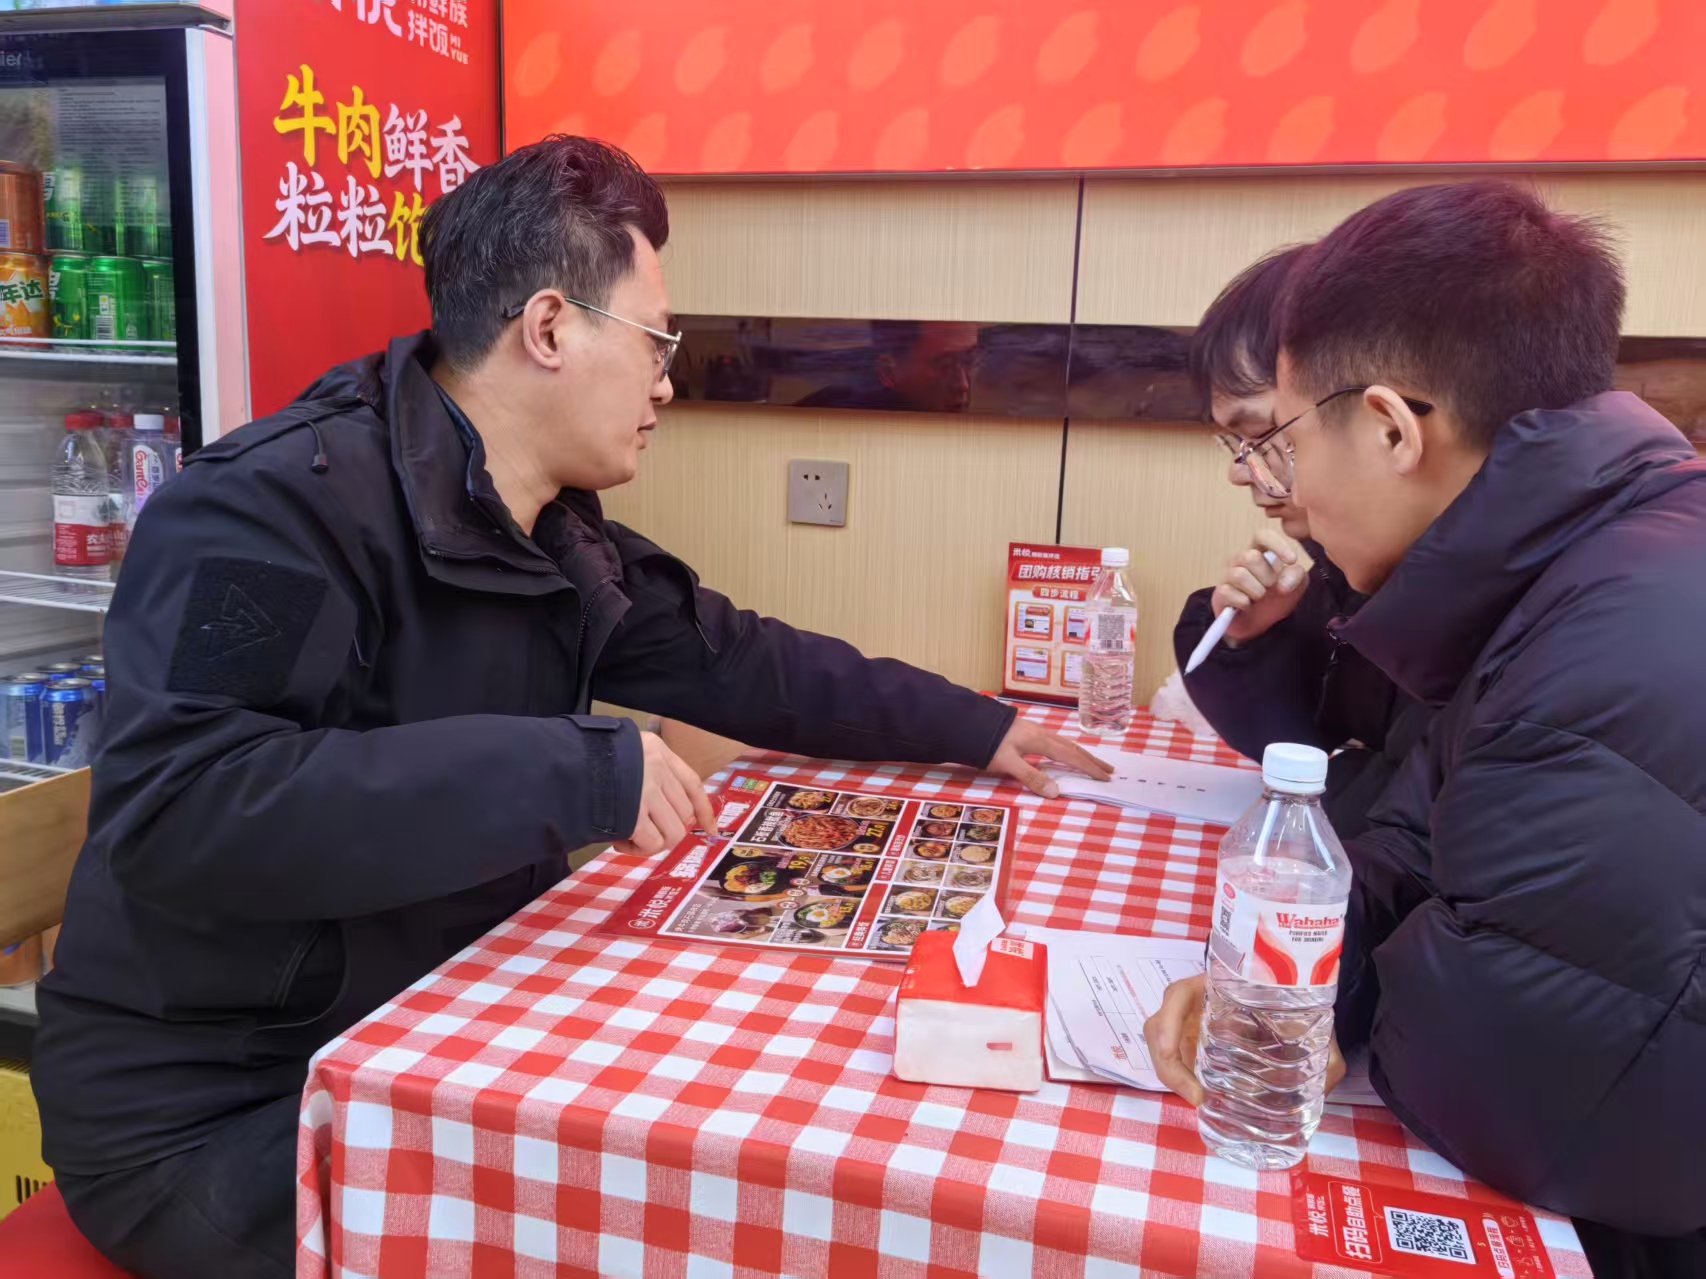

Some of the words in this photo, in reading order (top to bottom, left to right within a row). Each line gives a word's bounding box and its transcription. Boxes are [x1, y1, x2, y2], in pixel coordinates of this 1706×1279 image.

[450, 48, 468, 64] YUE
[273, 63, 481, 194] 牛肉鲜香
[1276, 912, 1339, 929] Wahaha
[1341, 1184, 1373, 1260] 扫码自助点餐
